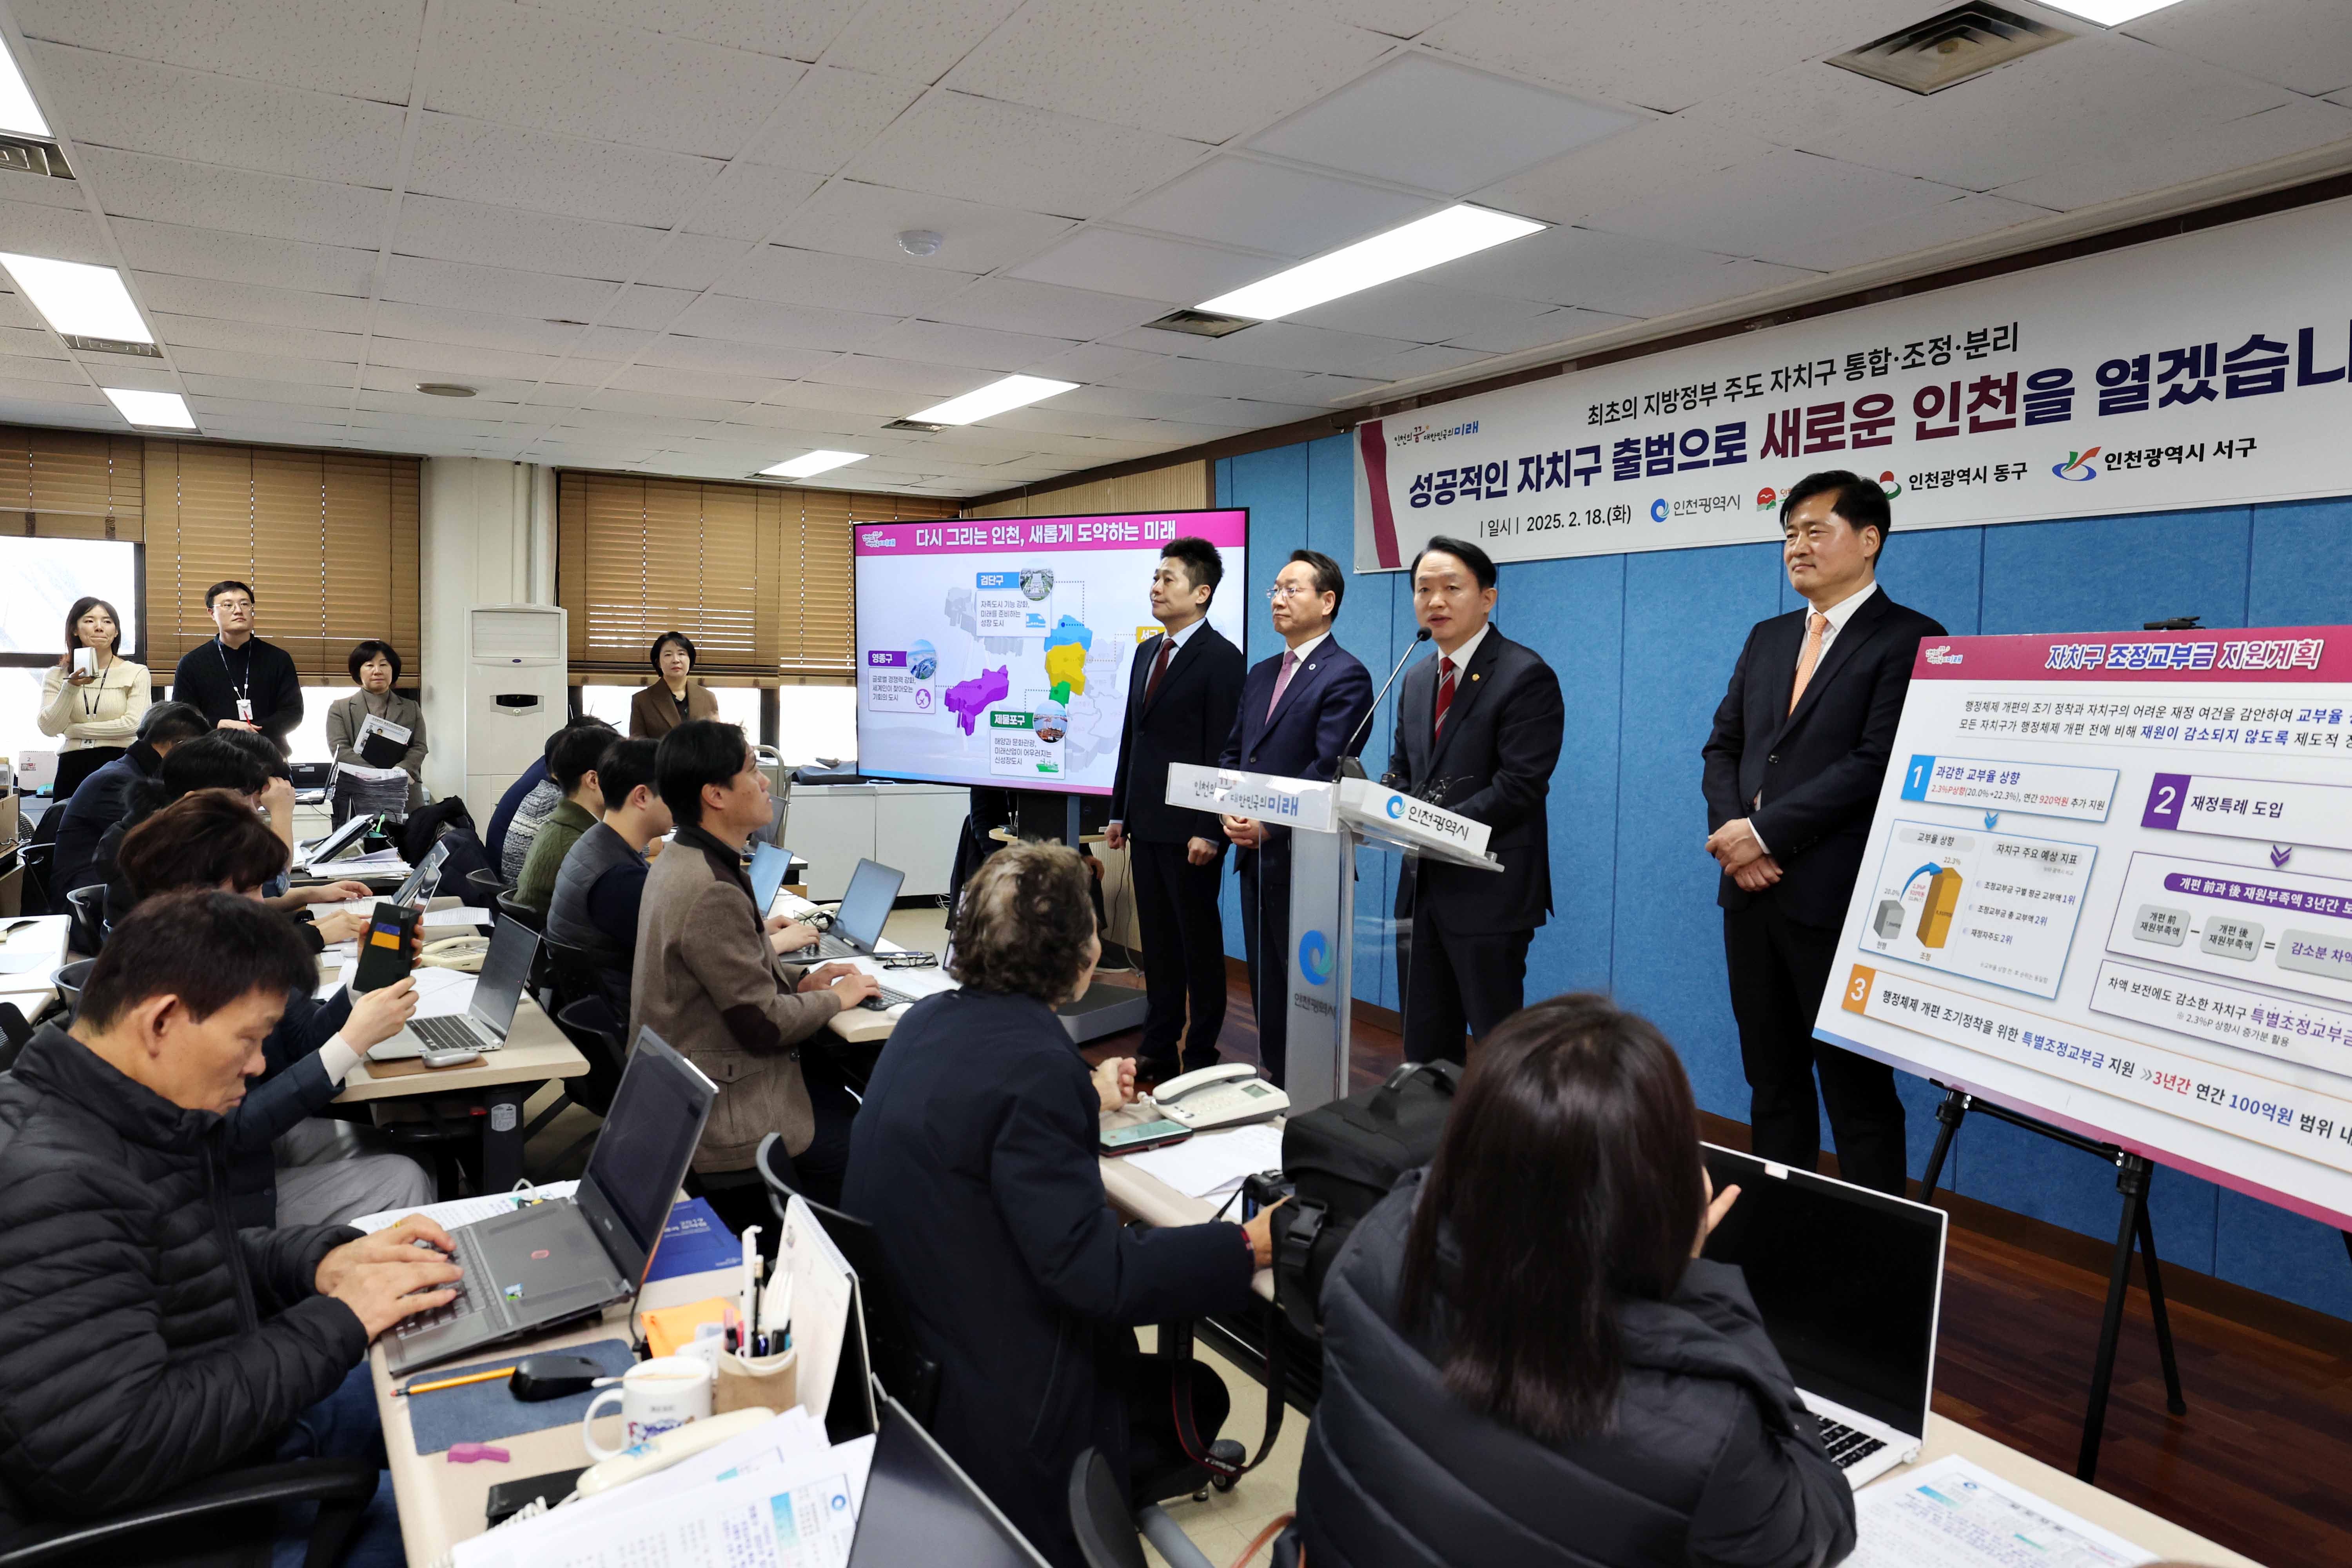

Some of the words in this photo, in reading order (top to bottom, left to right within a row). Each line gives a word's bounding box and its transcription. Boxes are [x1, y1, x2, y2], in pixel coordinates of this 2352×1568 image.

[1588, 396, 1637, 426] 최초의
[1644, 381, 1718, 416] 지방정부
[1724, 372, 1764, 402] 주도
[1771, 358, 1837, 393] 자치구
[1409, 460, 1508, 508] 성공적인
[1517, 444, 1602, 492] 자치구
[1613, 421, 1747, 482] 출범으로
[1760, 393, 1895, 460] 새로운
[1913, 368, 2075, 441] 인천을
[1454, 420, 1478, 436] 미래
[2105, 443, 2205, 471] 인천광역시
[2213, 437, 2257, 459] 서구
[1909, 465, 1987, 490] 인천광역시
[1994, 462, 2027, 482] 동구
[1674, 494, 1740, 517] 인천광역시
[916, 529, 942, 546] 다시
[946, 528, 987, 546] 그리는
[991, 526, 1024, 546] 인천,
[1029, 524, 1073, 543] 새롭게
[1078, 522, 1139, 542] 도약하는
[1145, 520, 1176, 540] 미래
[1527, 514, 1564, 532] 2025.
[981, 575, 1004, 586] 검단구
[872, 653, 893, 664] 영종구
[2045, 644, 2105, 670] 자치구
[2106, 642, 2218, 670] 조정교부금
[2218, 639, 2324, 670] 지원계획
[995, 714, 1025, 726] 제물포구
[1966, 701, 1999, 712] 행정체제
[2002, 702, 2030, 713] 개편의
[2032, 703, 2051, 715] 조기
[2055, 702, 2084, 716] 정착과
[2087, 704, 2129, 718] 자치구의
[2134, 705, 2167, 719] 어려운
[2171, 707, 2194, 720] 재정
[2199, 707, 2235, 721] 여건을
[2240, 708, 2293, 722] 감안하여
[2296, 709, 2343, 724] 교부율
[1960, 719, 1977, 730] 모든
[1980, 719, 2017, 731] 자치구가
[2021, 721, 2060, 734] 행정체제
[2063, 723, 2085, 735] 개편
[2089, 724, 2110, 737] 전에
[2115, 724, 2137, 738] 비해
[2141, 726, 2178, 740] 재원이
[2185, 727, 2239, 742] 감소되지
[2245, 730, 2289, 745] 않도록
[2294, 732, 2339, 748] 제도적
[995, 748, 1022, 756] 미래산업이
[1913, 765, 1923, 788] 1
[1936, 766, 1964, 780] 과감한
[1967, 769, 1996, 783] 교부율
[2000, 771, 2020, 785] 상향
[1268, 795, 1298, 816] 미래
[2024, 793, 2038, 803] 연간
[2040, 796, 2069, 807] 920억원
[2071, 798, 2086, 808] 추가
[2089, 800, 2105, 810] 지원
[2154, 786, 2176, 815] 2
[2191, 795, 2249, 815] 재정특례
[2252, 802, 2284, 819] 도입
[1408, 807, 1469, 840] 인천광역시
[1918, 833, 1938, 844] 교부율
[1940, 835, 1955, 847] 상향
[1996, 844, 2020, 856] 자치구
[2023, 848, 2038, 858] 주요
[2041, 850, 2058, 862] 예상
[2060, 853, 2078, 864] 지표
[1984, 882, 2013, 894] 조정교부금
[2042, 891, 2062, 902] 교부액
[2062, 895, 2076, 905] 1위
[2180, 877, 2201, 891] 개편
[2203, 880, 2227, 895] 前과
[2229, 884, 2241, 898] 後
[2244, 886, 2303, 907] 재원부족액
[2305, 896, 2339, 913] 3년간
[1978, 906, 2006, 918] 조정교부금
[2015, 913, 2034, 923] 교부액
[2034, 916, 2047, 926] 2위
[2150, 912, 2166, 923] 개편
[2168, 915, 2177, 925] 前
[1971, 929, 2000, 942] 재정자주도
[2000, 935, 2013, 945] 2위
[2140, 921, 2180, 938] 재원부족액
[2219, 924, 2236, 935] 개편
[2209, 934, 2253, 951] 재원부족액
[2291, 942, 2327, 960] 감소분
[1850, 978, 1866, 1001] 3
[2108, 977, 2128, 992] 차액
[2131, 982, 2172, 1002] 보전에도
[2176, 993, 2209, 1011] 감소한
[2212, 1002, 2247, 1019] 자치구
[2186, 1014, 2213, 1027] 2.3%P
[2215, 1020, 2240, 1035] 상향시
[2242, 1028, 2269, 1042] 증가분
[2271, 1034, 2290, 1048] 활용
[1883, 989, 1919, 1012] 행정체제
[1920, 1000, 1940, 1018] 개편
[1942, 1009, 1994, 1035] 조기정착을
[1997, 1024, 2019, 1043] 위한
[2022, 1031, 2105, 1069] 특별조정교부금
[2108, 1058, 2135, 1078] 지원
[2152, 1071, 2191, 1095] 3년간
[2196, 1082, 2226, 1105] 연간
[2229, 1094, 2294, 1127] 100억원
[2300, 1113, 2334, 1138] 범위
